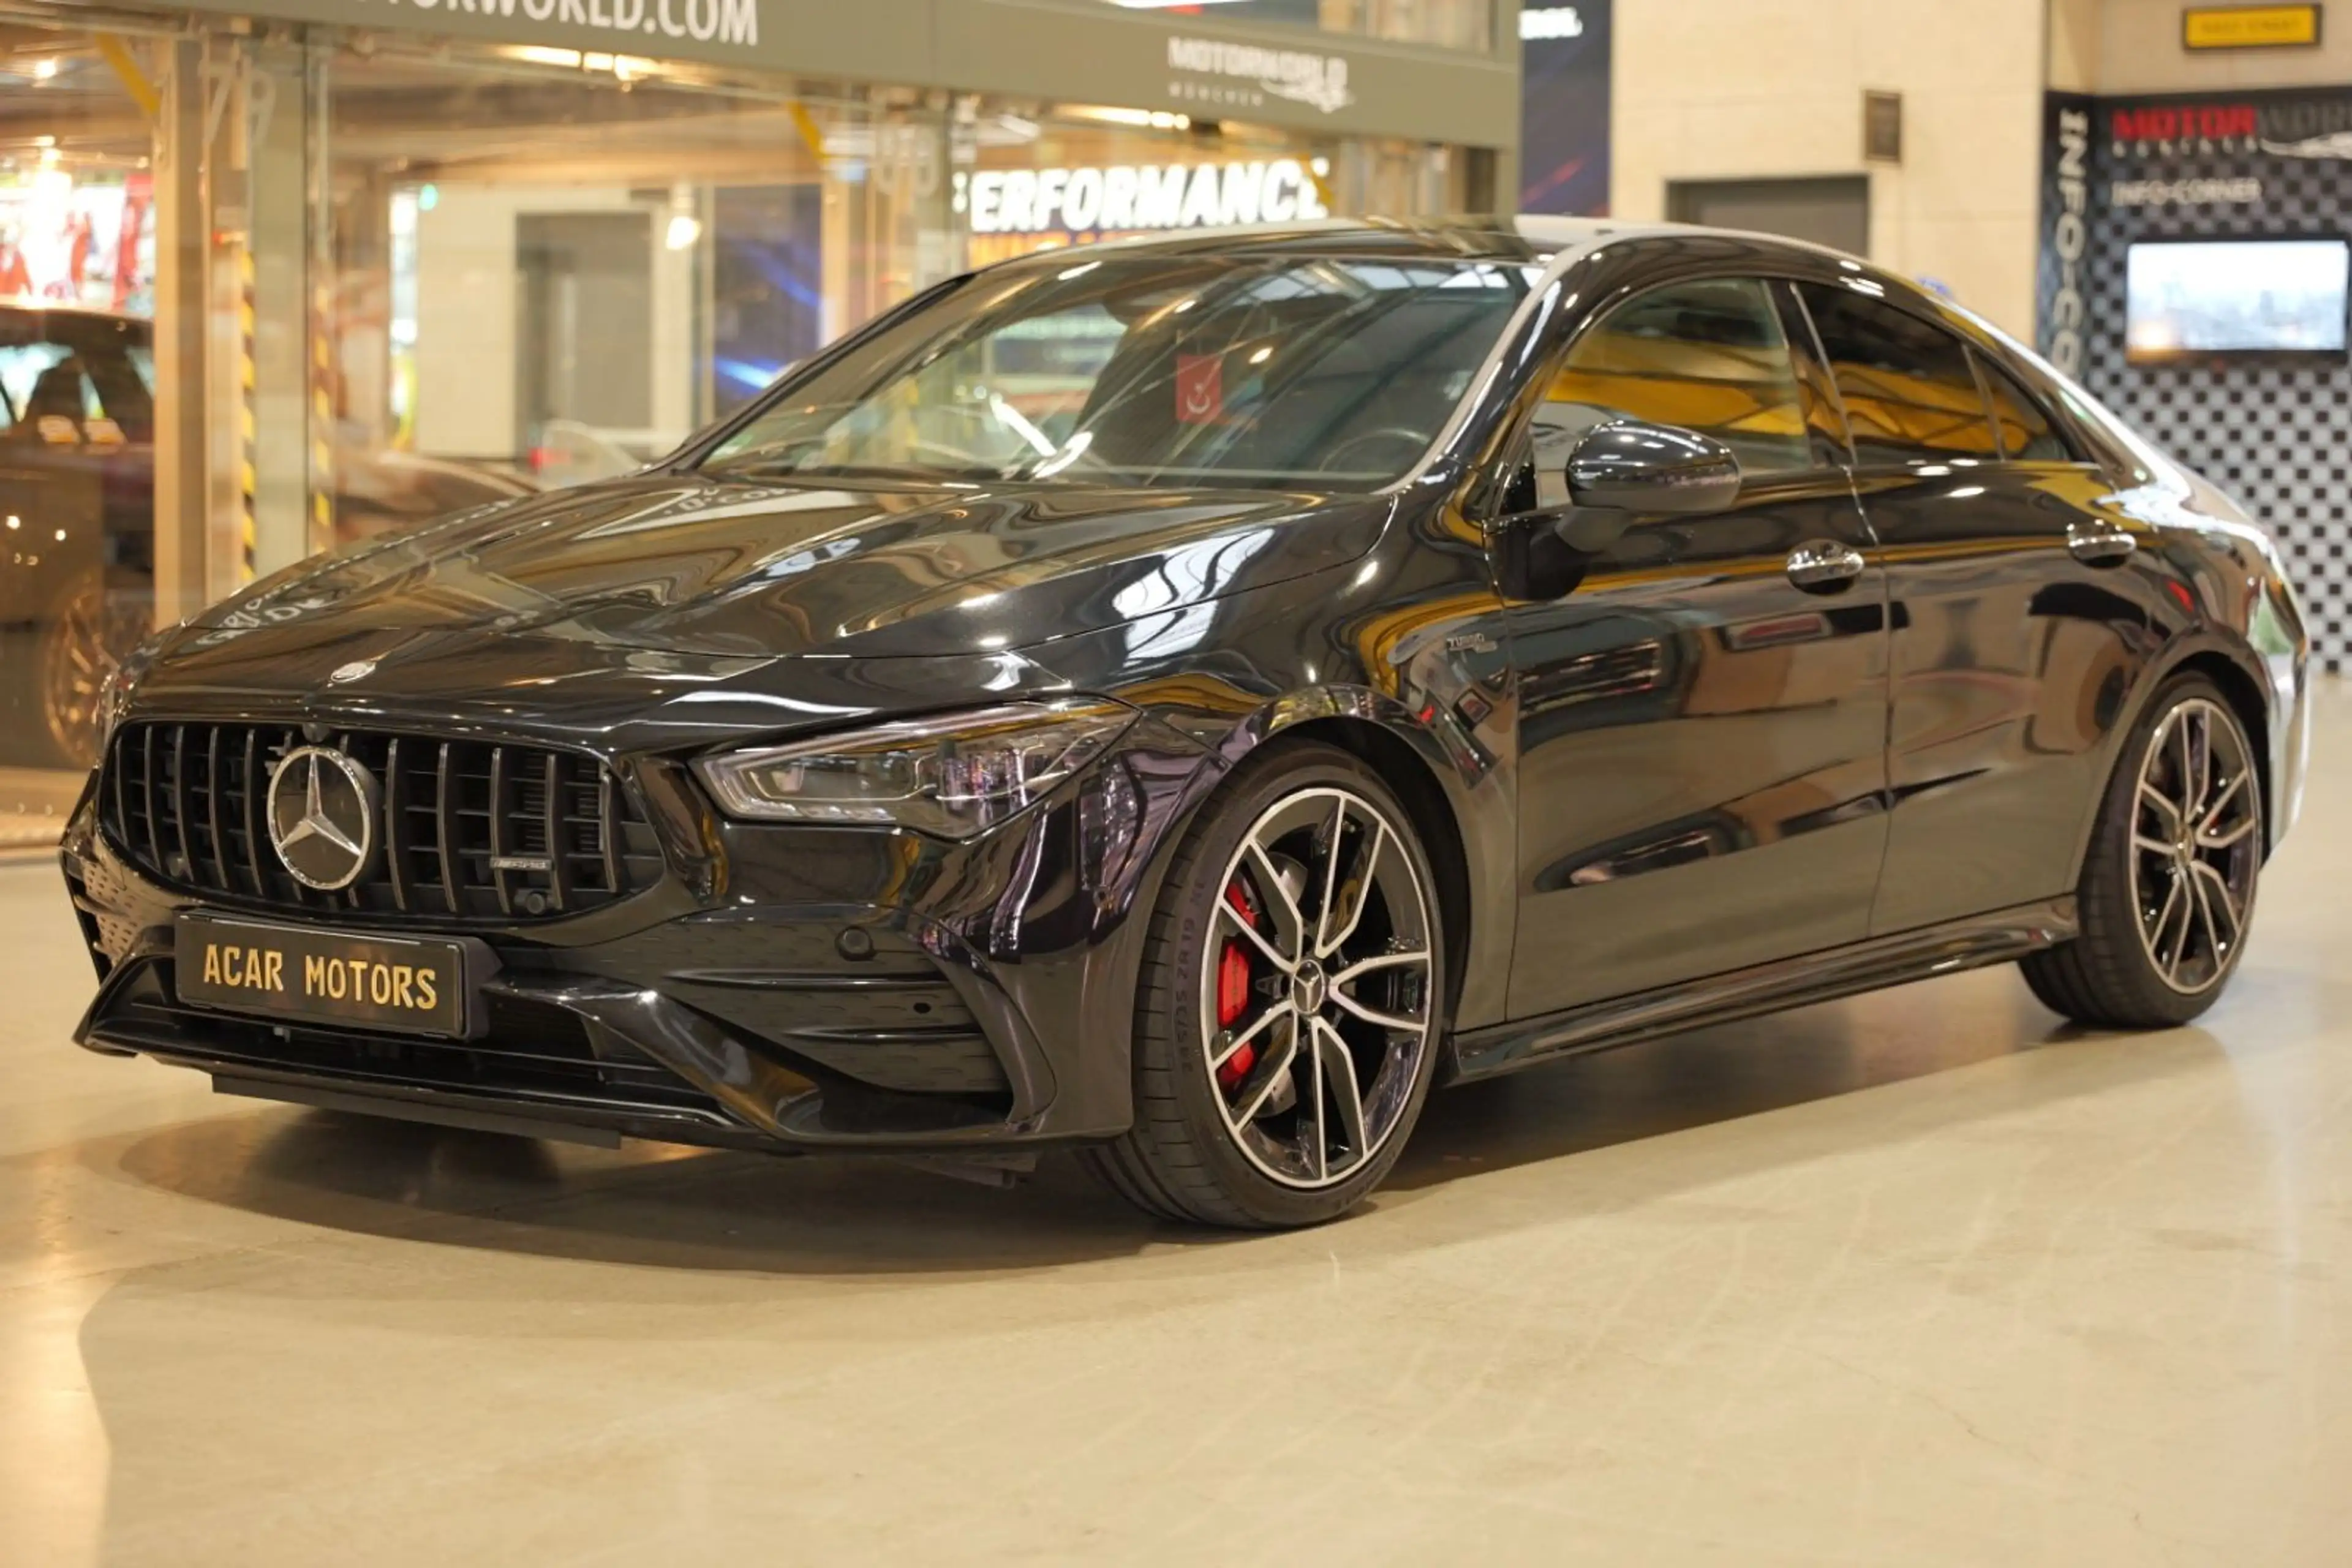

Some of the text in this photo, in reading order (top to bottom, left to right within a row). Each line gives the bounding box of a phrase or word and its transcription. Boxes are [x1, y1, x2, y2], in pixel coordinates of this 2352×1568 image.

[952, 156, 1331, 232] ERFORMANCE
[203, 943, 437, 1011] ACAR MOTORS
